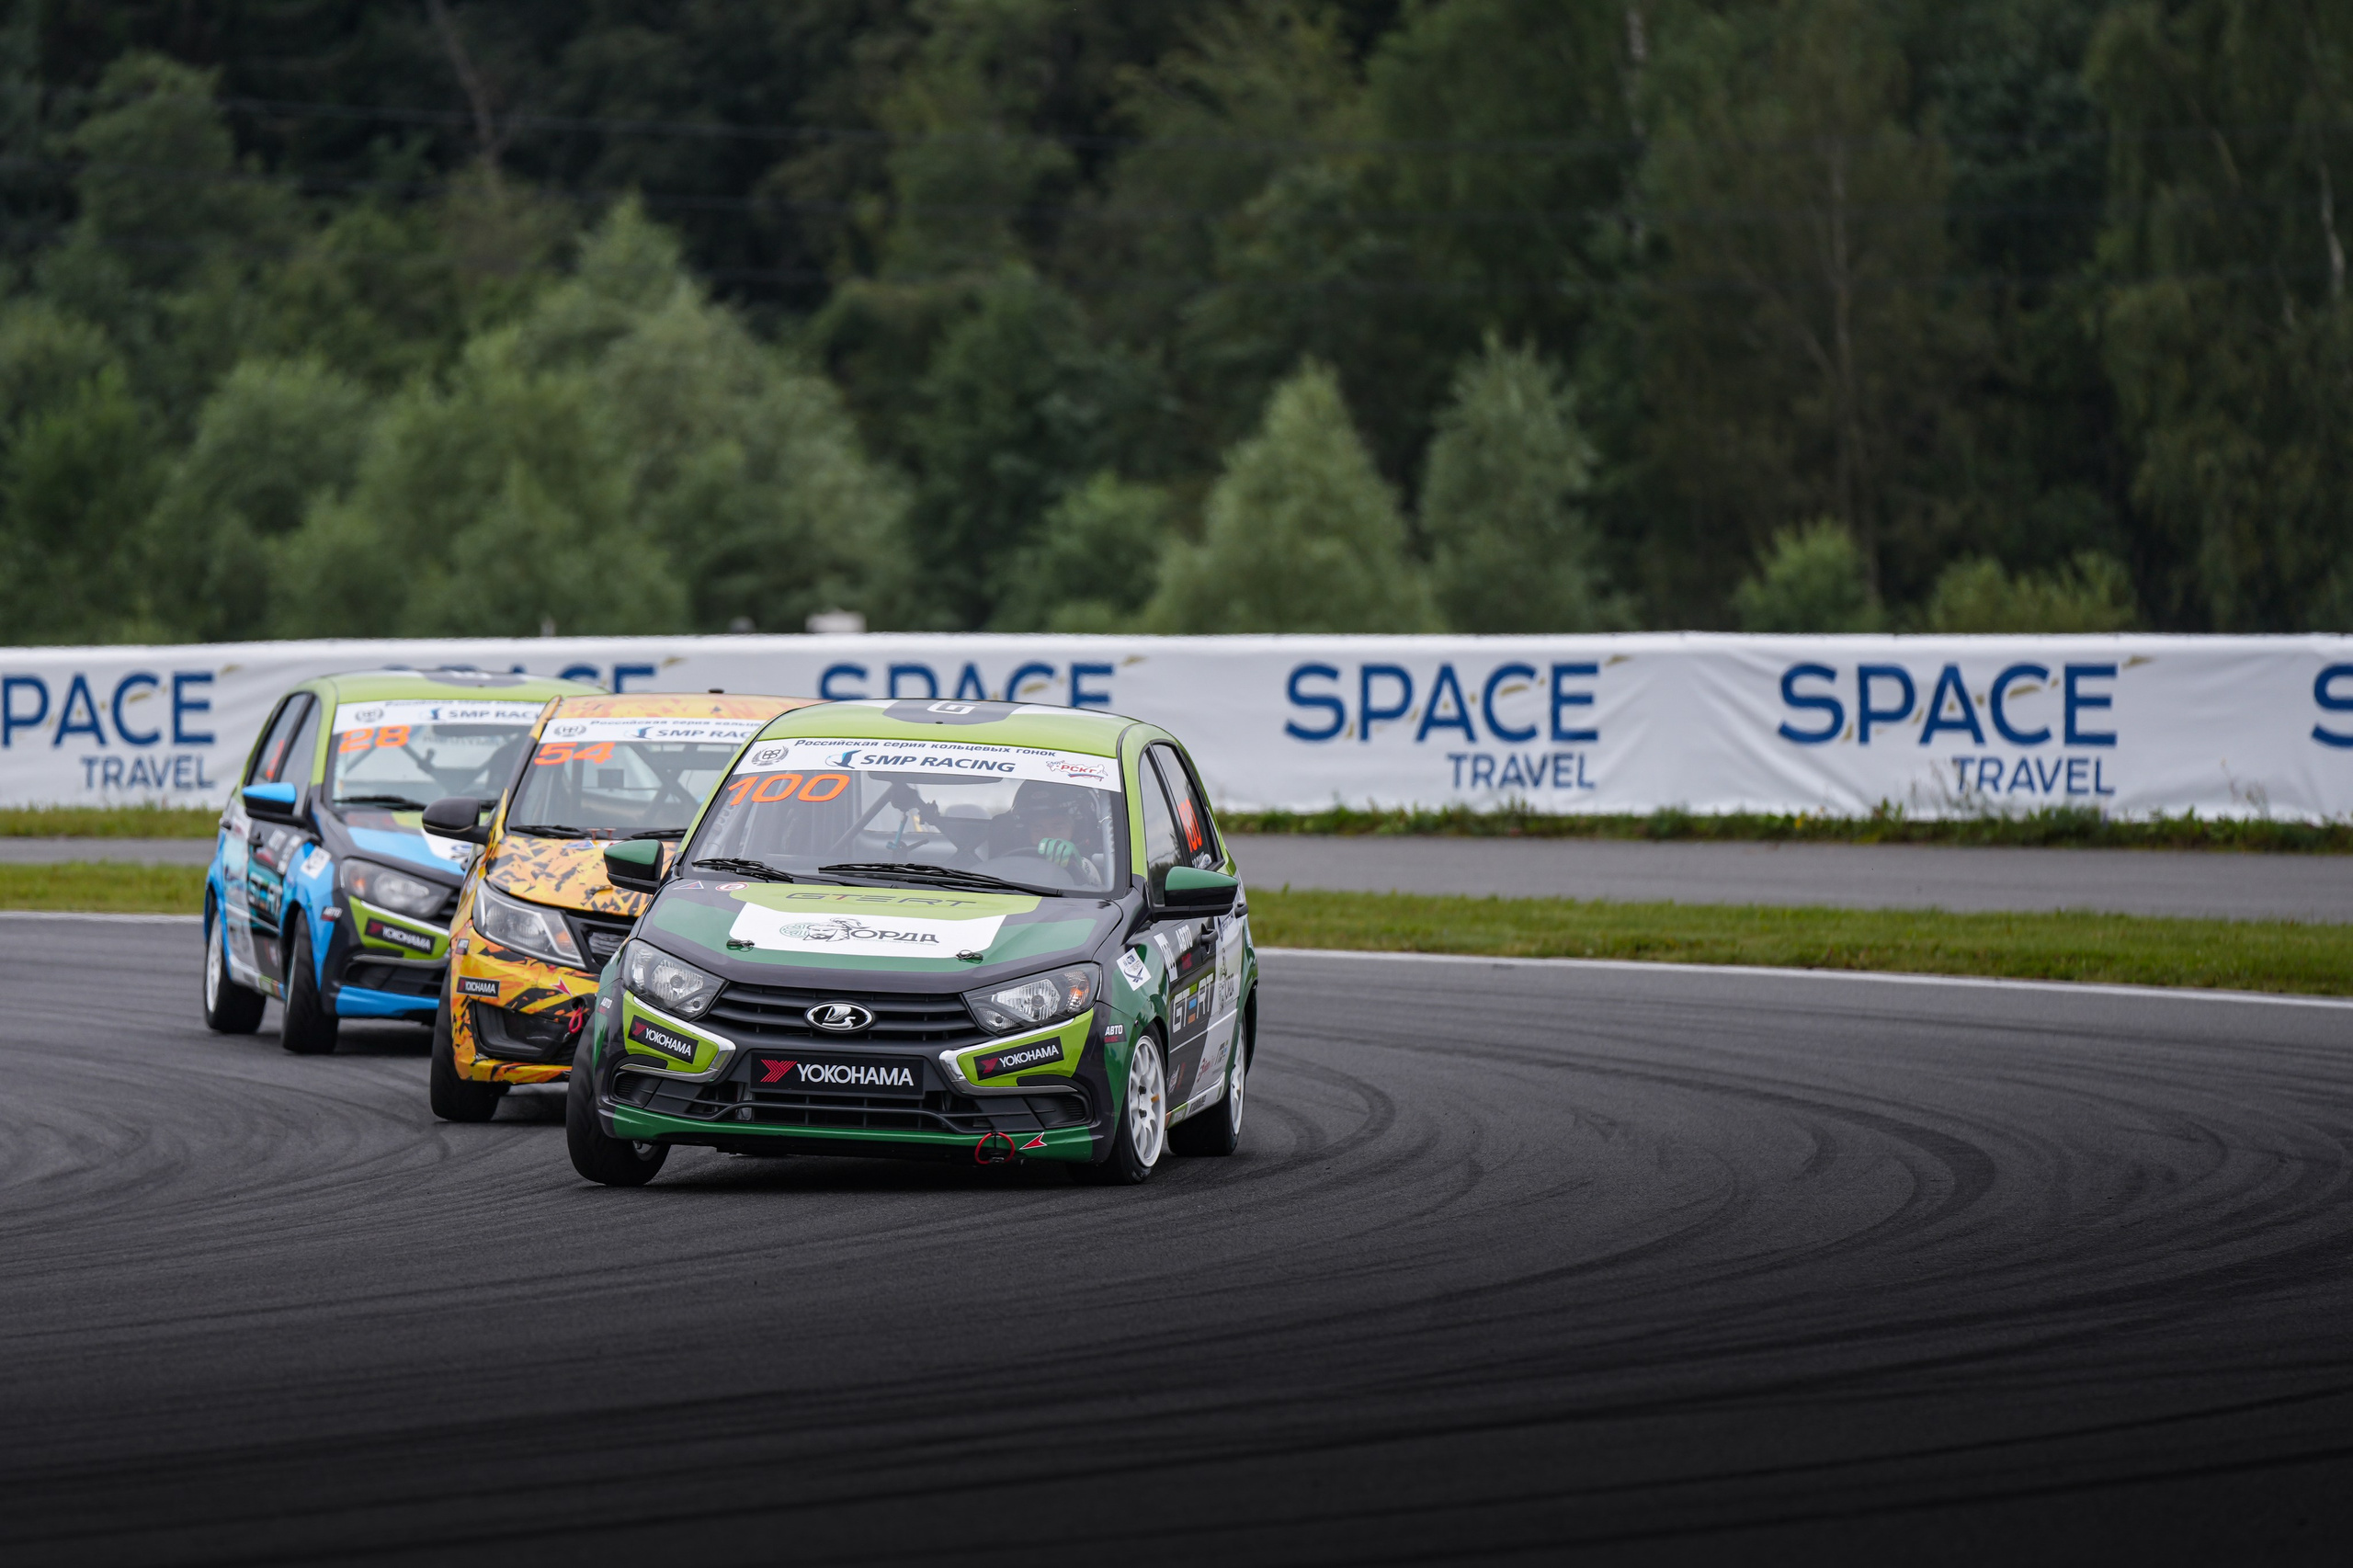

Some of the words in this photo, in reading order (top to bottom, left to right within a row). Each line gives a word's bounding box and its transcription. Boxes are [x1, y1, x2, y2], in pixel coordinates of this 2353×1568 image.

[1, 671, 216, 746] PACE
[449, 710, 490, 719] SMP
[1284, 661, 1600, 744] SPACE
[1778, 661, 2118, 746] SPACE
[339, 724, 411, 754] 28
[656, 729, 705, 738] SMP
[794, 739, 879, 747] Российская
[883, 741, 927, 749] серия
[931, 743, 1011, 753] кольцевых
[1016, 748, 1057, 757] гонок
[534, 741, 617, 766] 54
[859, 755, 917, 767] SMP
[920, 756, 1017, 773] RACING
[81, 755, 216, 790] TRAVEL
[1447, 753, 1595, 789] TRAVEL
[1953, 756, 2115, 795] TRAVEL
[727, 773, 851, 807] 100
[1176, 798, 1203, 853] 100
[382, 926, 431, 950] YOKOHAMA
[850, 929, 940, 944] ОРДА
[645, 1028, 692, 1057] YOKOHAMA
[999, 1044, 1060, 1068] YOKOHAMA
[796, 1063, 915, 1086] YOKOHAMA
